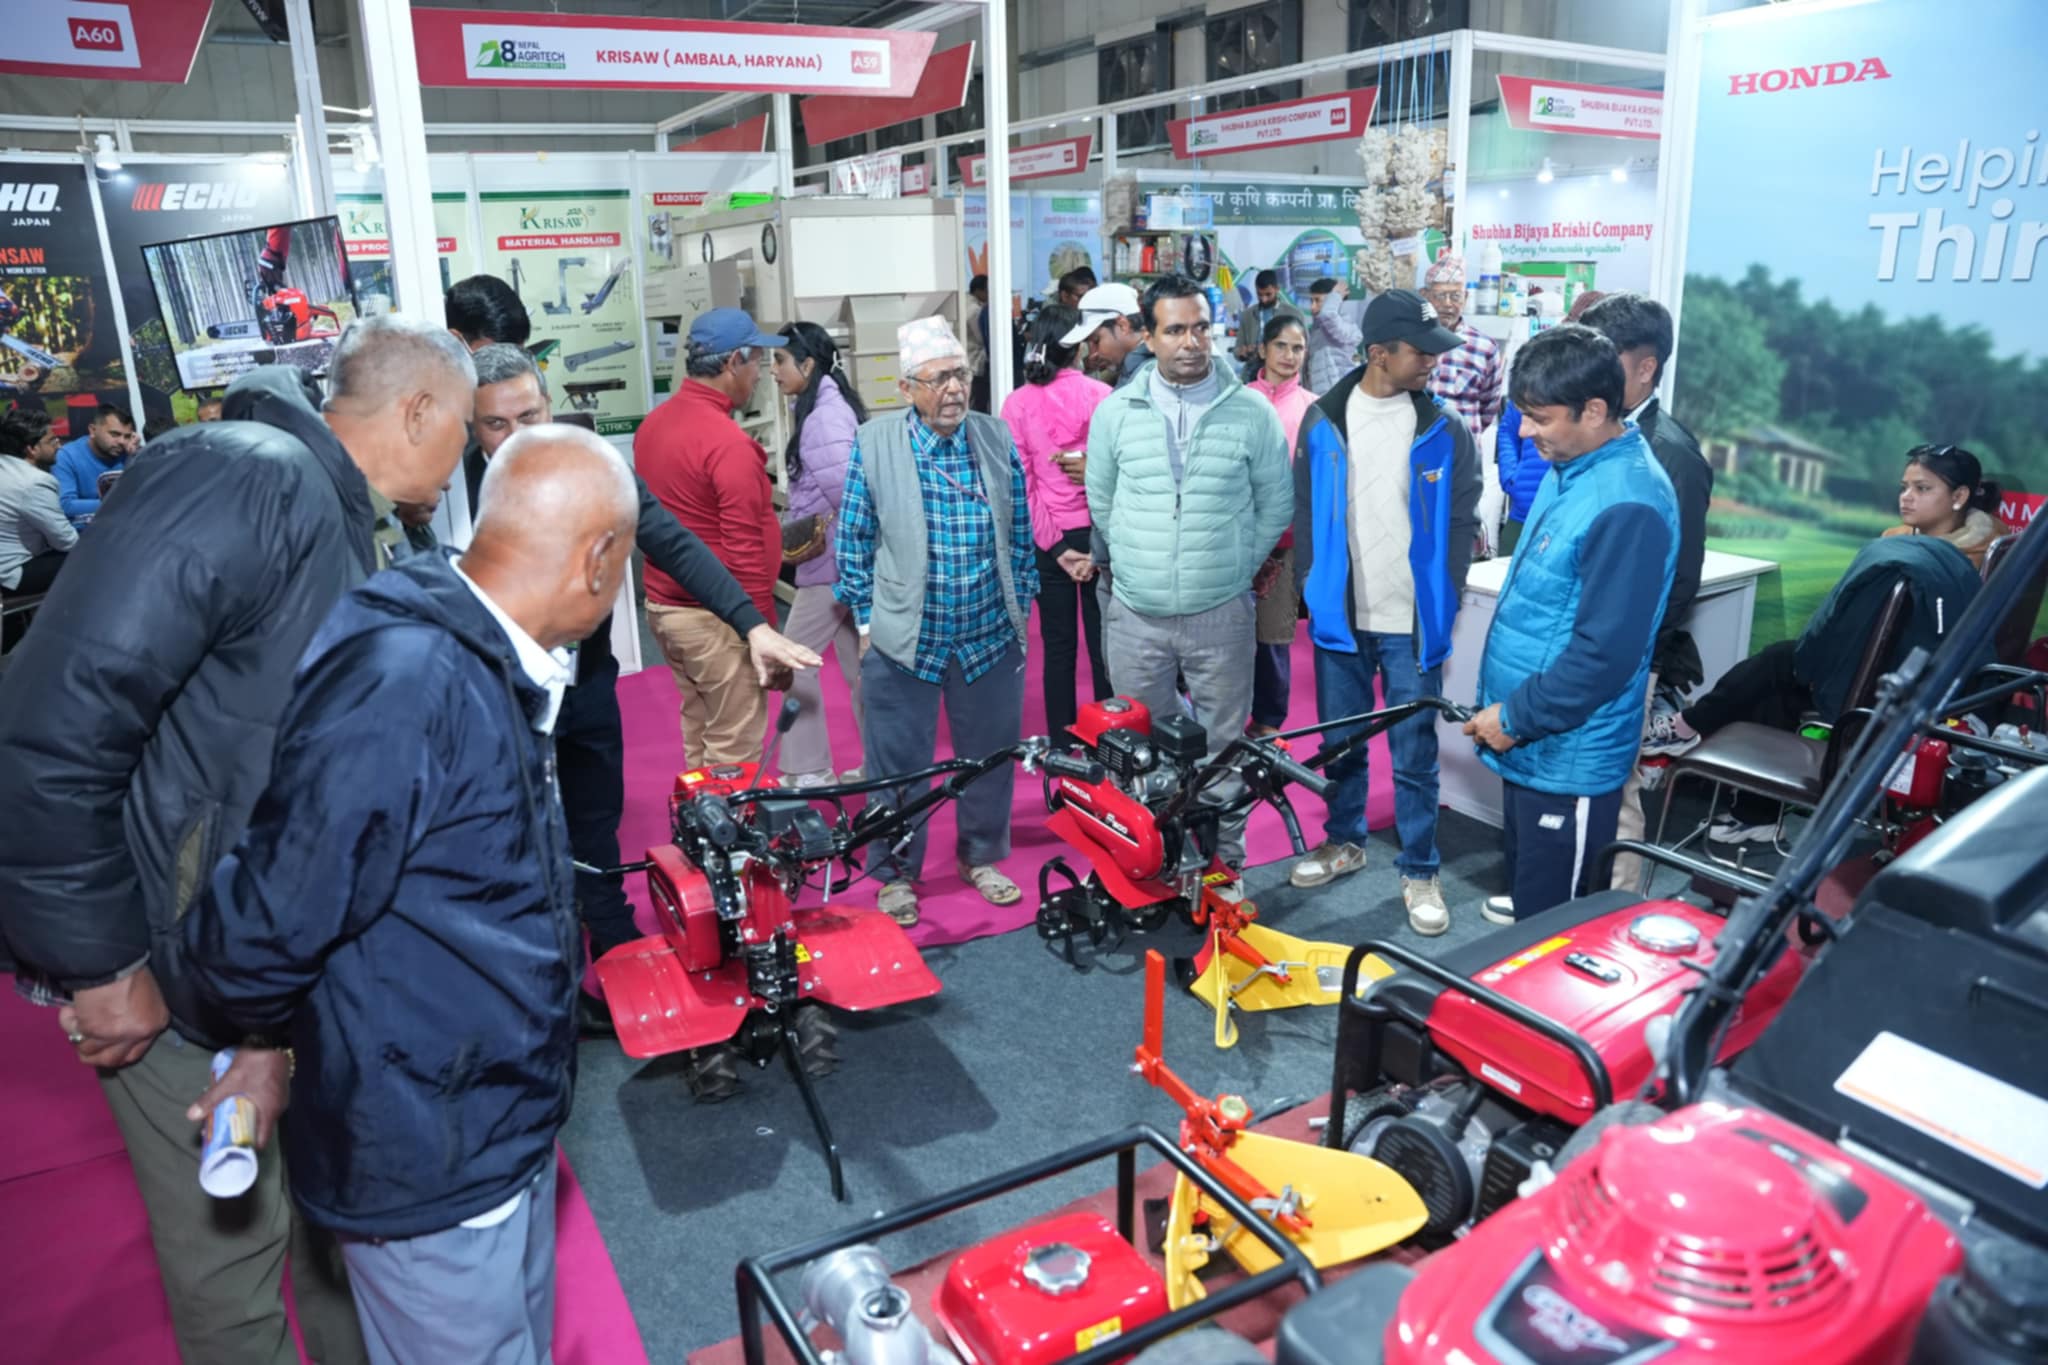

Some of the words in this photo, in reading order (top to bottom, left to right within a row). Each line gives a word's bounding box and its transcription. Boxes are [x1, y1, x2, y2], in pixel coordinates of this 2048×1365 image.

[75, 26, 115, 44] A60
[518, 51, 565, 61] AGRITECH
[596, 50, 659, 65] KRISAW
[674, 53, 741, 69] AMBALA,
[745, 54, 822, 72] HARYANA)
[1728, 56, 1892, 96] HONDA
[161, 182, 257, 211] ECHO
[1229, 186, 1261, 215] कृषि
[1265, 187, 1314, 208] कम्पनी
[11, 217, 51, 226] JAPAN
[520, 207, 583, 230] KRISAW
[504, 237, 559, 248] MATERIAL
[560, 235, 614, 245] HANDLING
[1472, 224, 1512, 240] Shubha
[1514, 223, 1550, 243] Bijaya
[1552, 222, 1591, 239] Krishi
[1592, 221, 1654, 241] Company
[1062, 779, 1092, 803] HONDA
